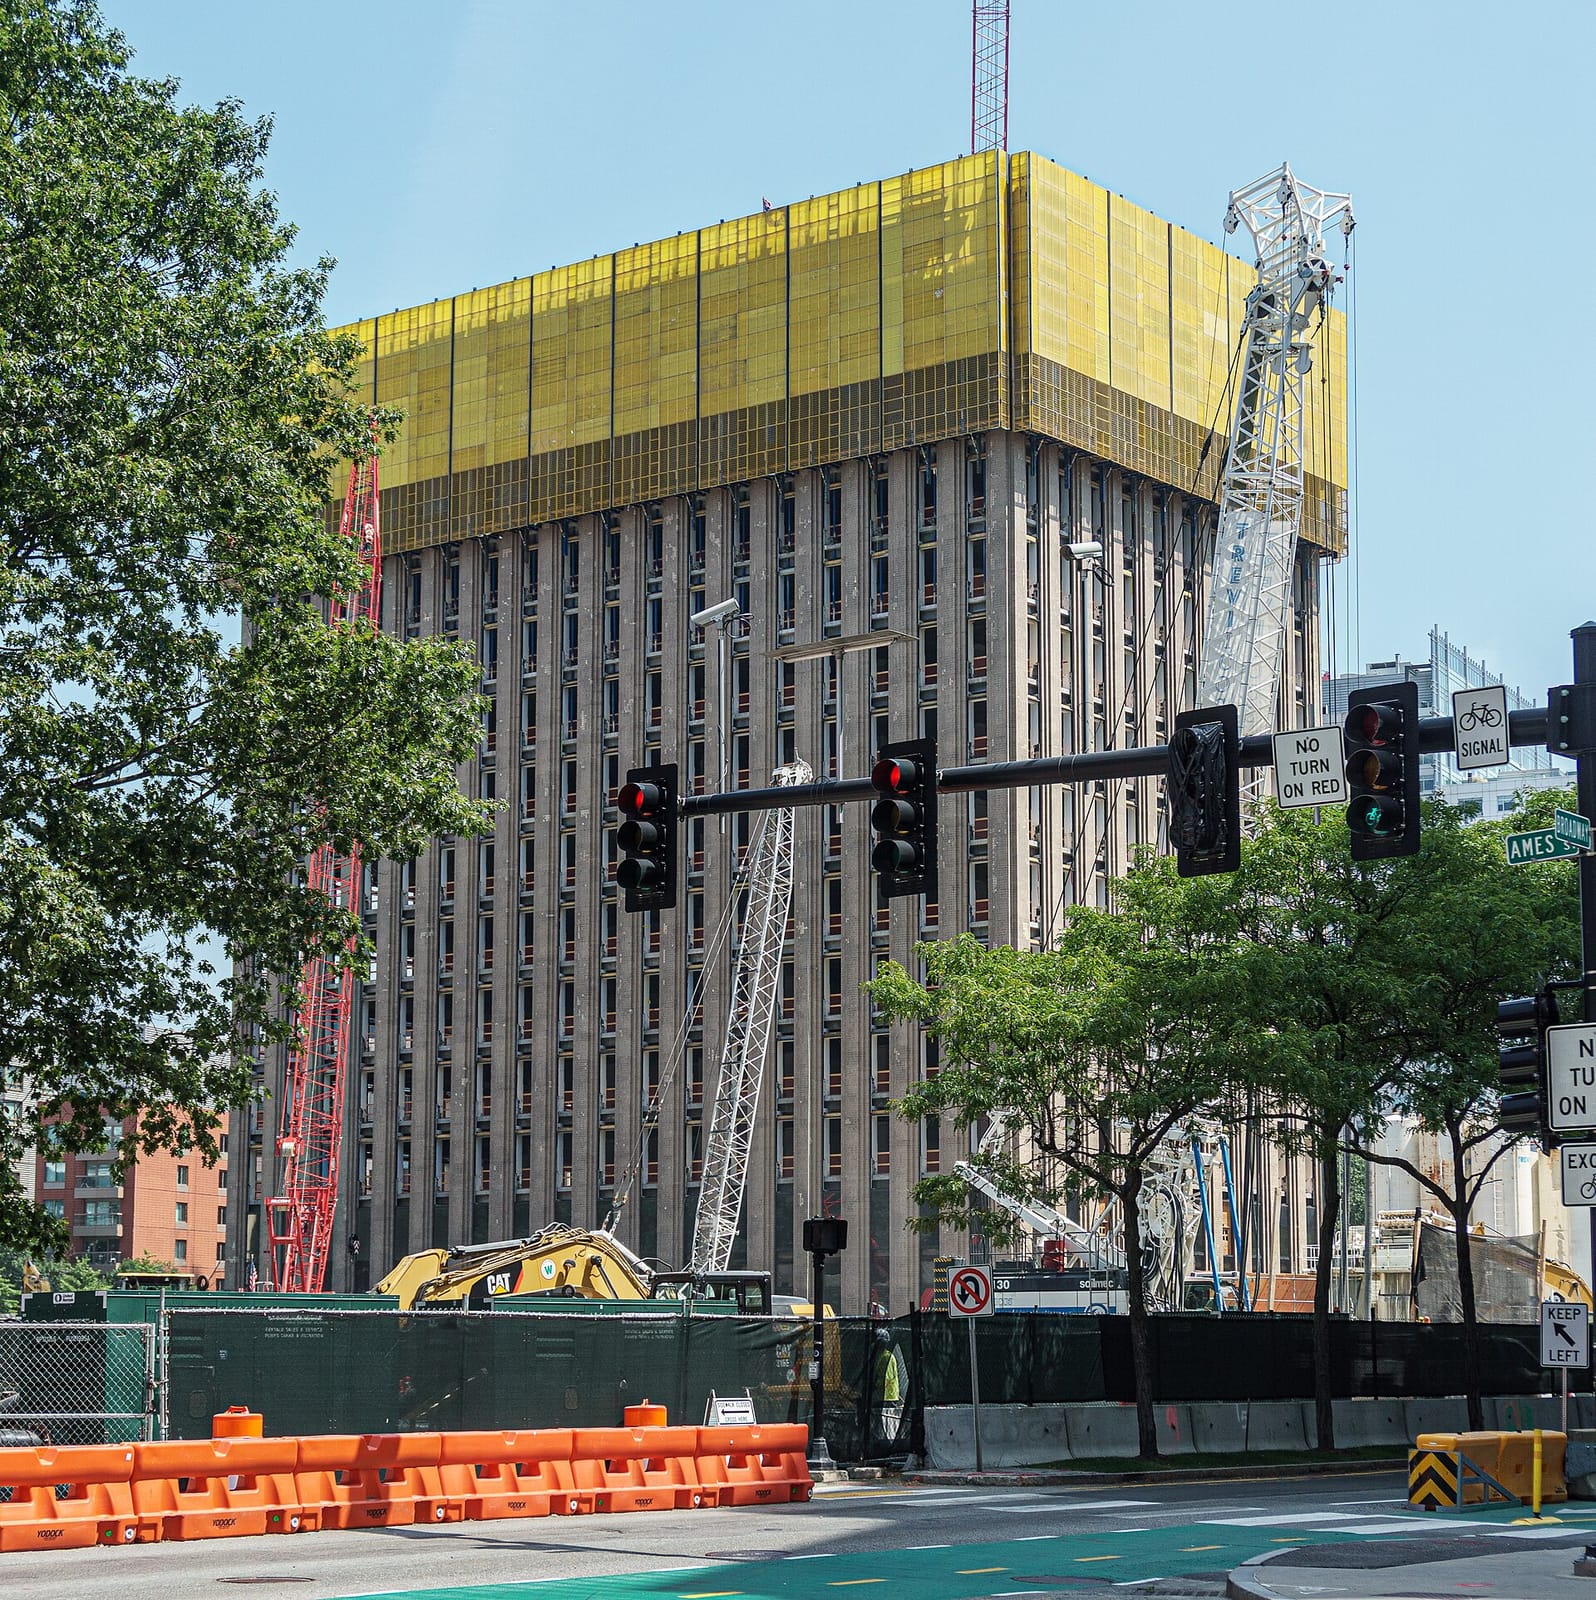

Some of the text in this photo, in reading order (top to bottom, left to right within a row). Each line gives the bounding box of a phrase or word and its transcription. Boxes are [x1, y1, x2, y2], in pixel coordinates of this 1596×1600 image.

[1296, 738, 1320, 754] NO
[1461, 738, 1504, 757] SIGNAL
[1289, 758, 1330, 776] TURN
[1283, 778, 1340, 799] ON RED
[1556, 814, 1589, 843] BROADWAY
[1511, 834, 1555, 859] AMES
[1559, 1095, 1587, 1116] ON
[486, 1272, 511, 1296] CAT
[1548, 1307, 1581, 1320] KEEP
[1549, 1349, 1580, 1362] LEFT
[37, 1528, 65, 1538] YODOCK
